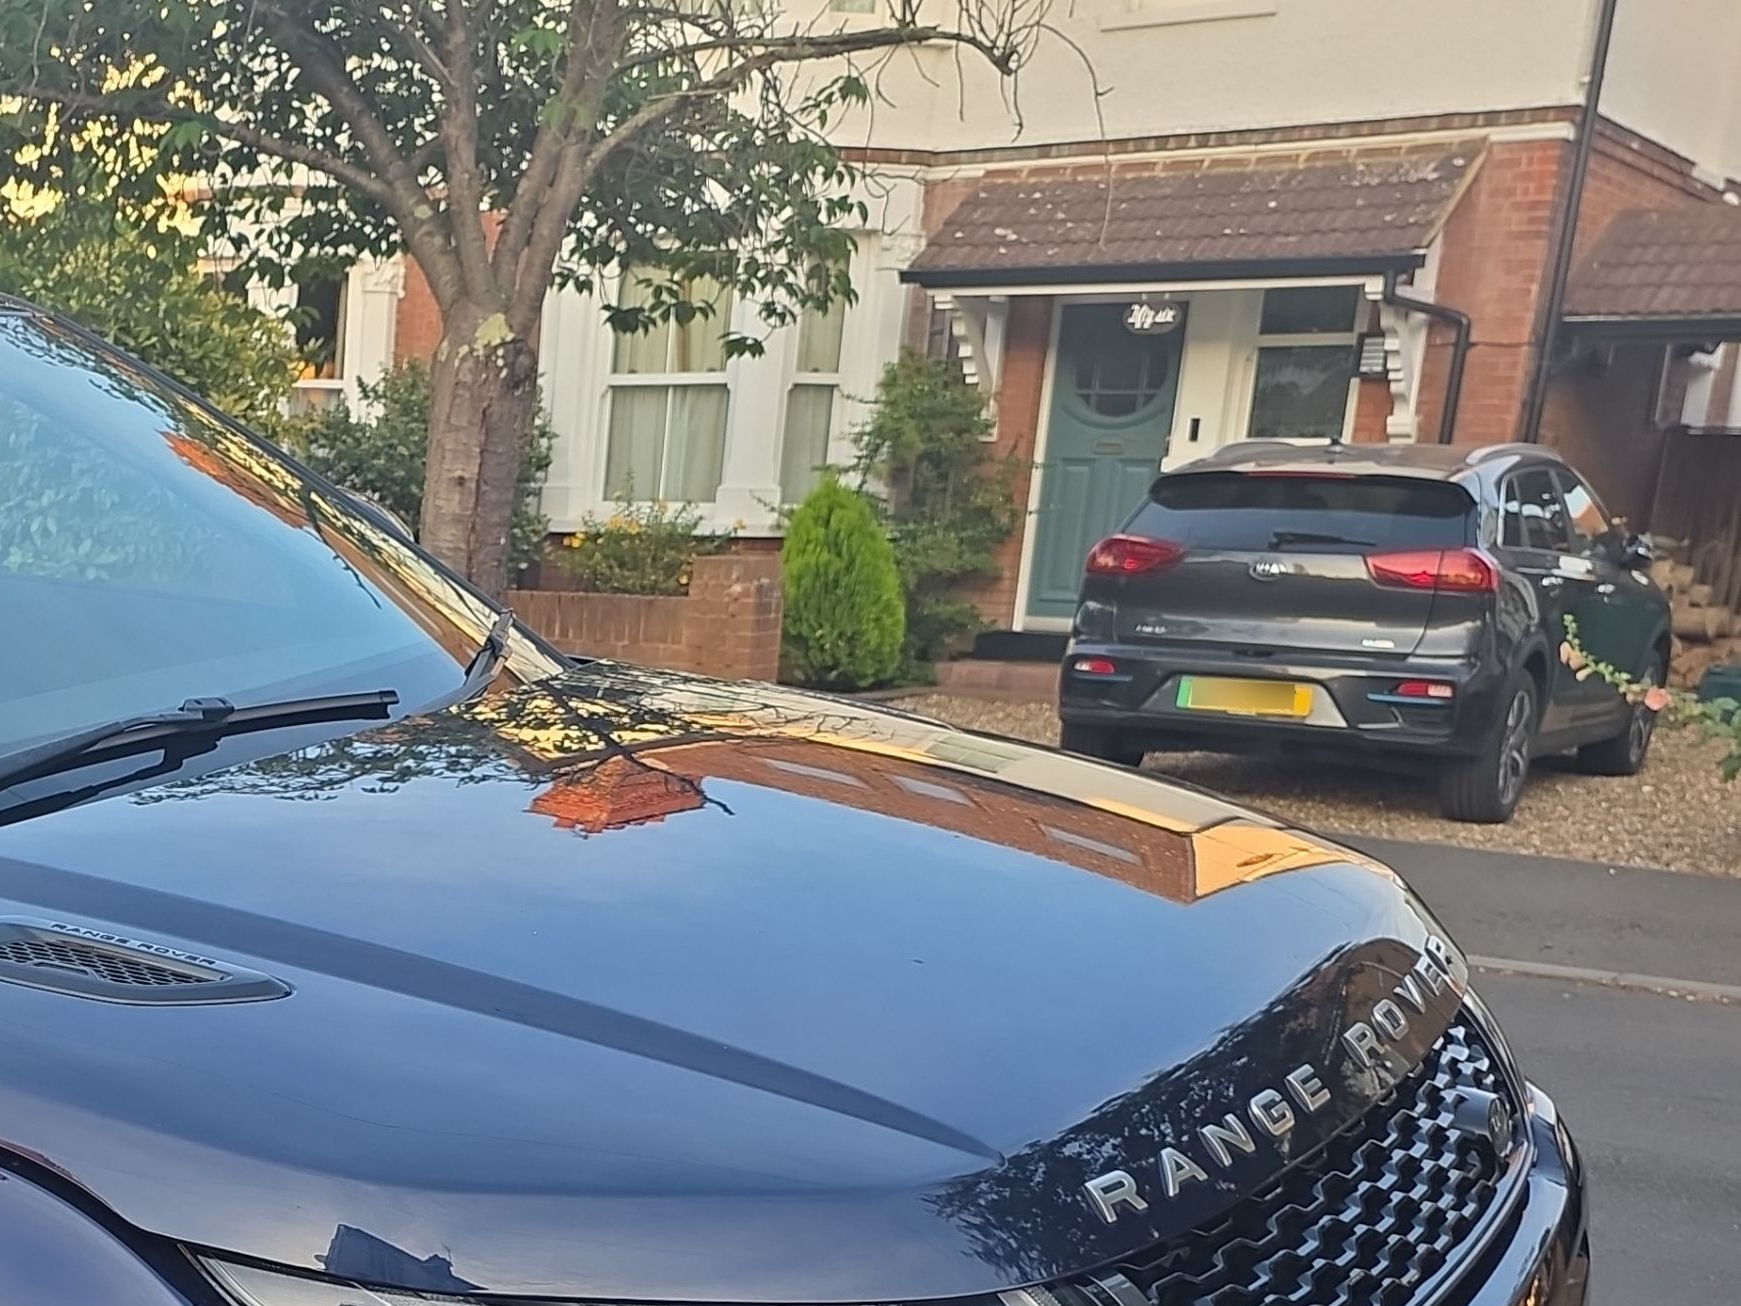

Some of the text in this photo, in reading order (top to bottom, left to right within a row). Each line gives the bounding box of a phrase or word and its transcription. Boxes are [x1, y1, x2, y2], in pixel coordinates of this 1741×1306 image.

[50, 922, 217, 967] RANGE ROVER
[1083, 1063, 1332, 1224] RANGE
[1337, 934, 1455, 1068] ROVER
